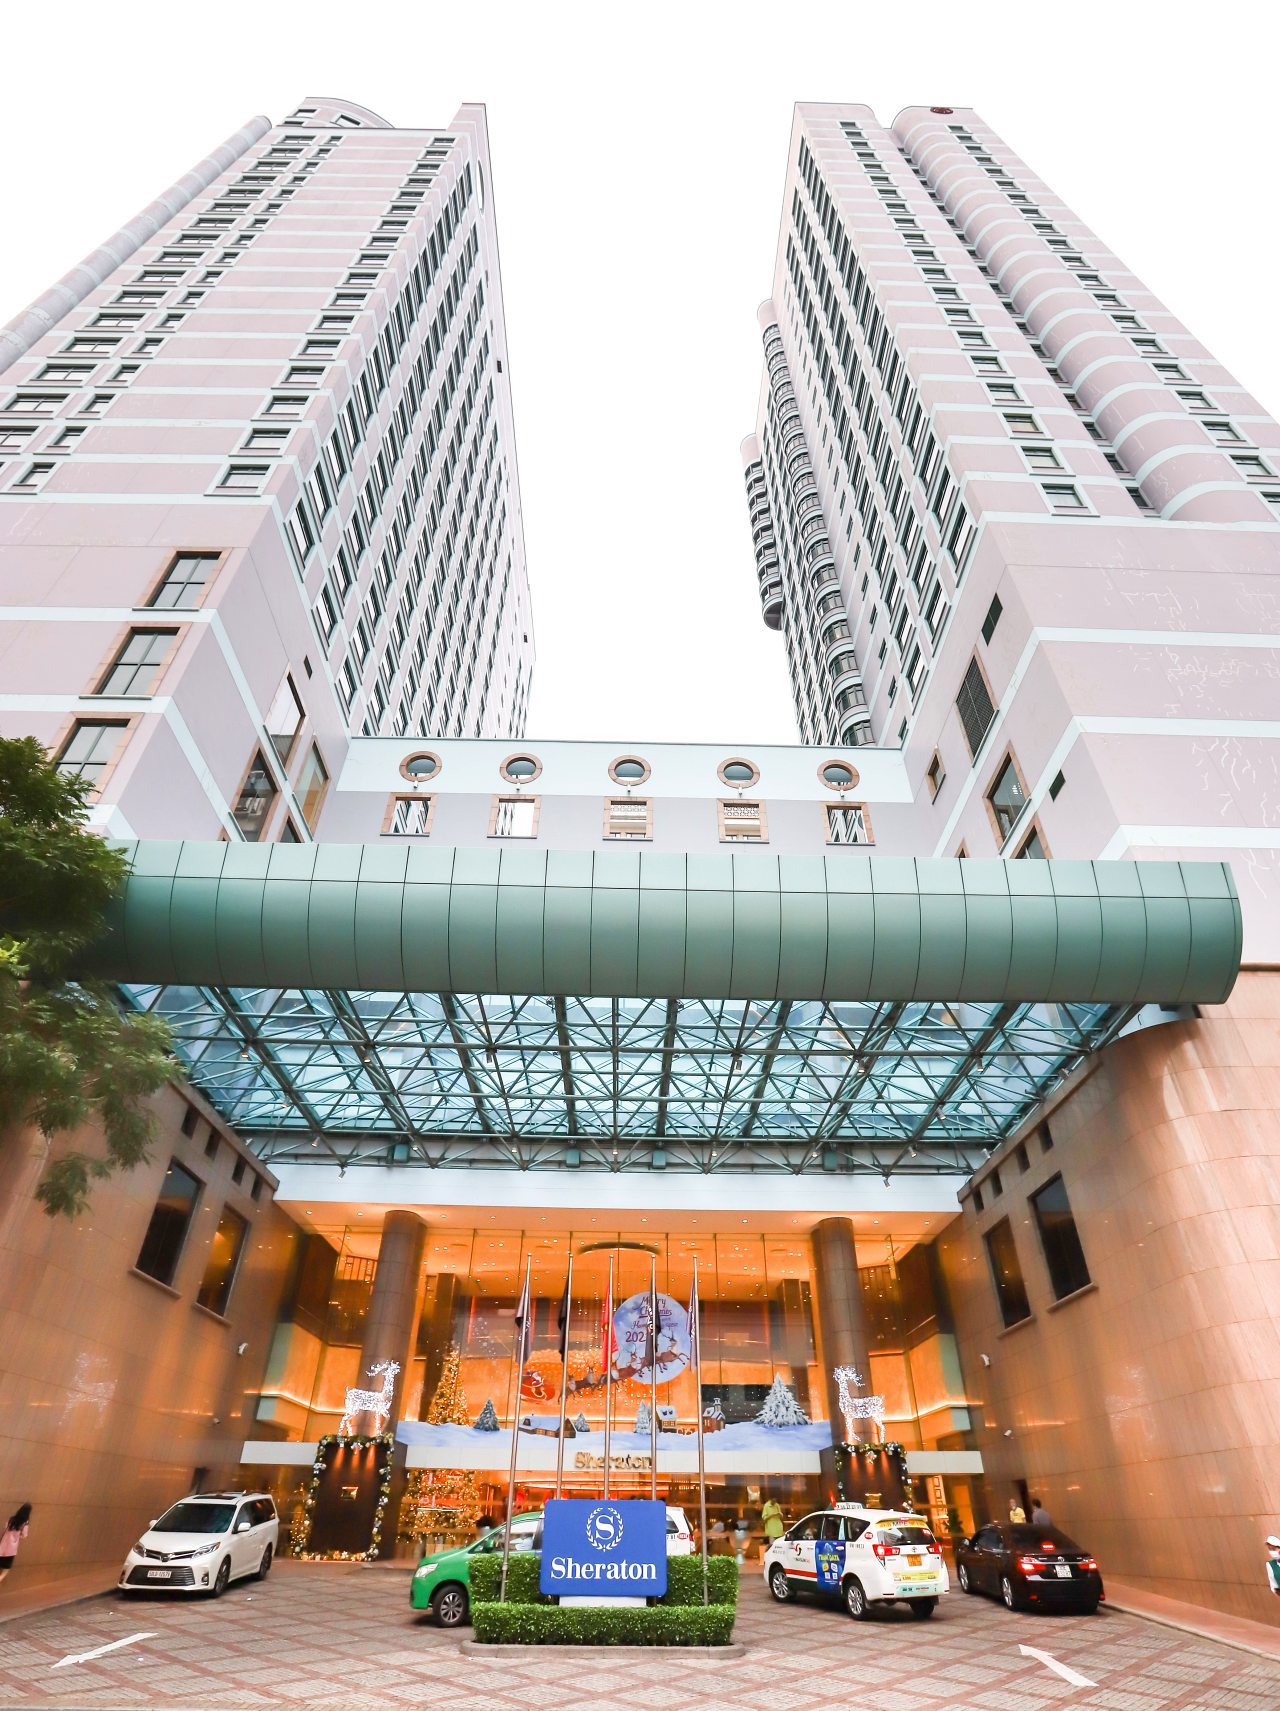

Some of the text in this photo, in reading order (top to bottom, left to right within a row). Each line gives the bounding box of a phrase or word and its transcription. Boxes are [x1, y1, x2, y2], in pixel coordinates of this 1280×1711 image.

[625, 1331, 647, 1343] 202
[595, 1514, 615, 1540] S
[550, 1556, 657, 1580] Sheraton
